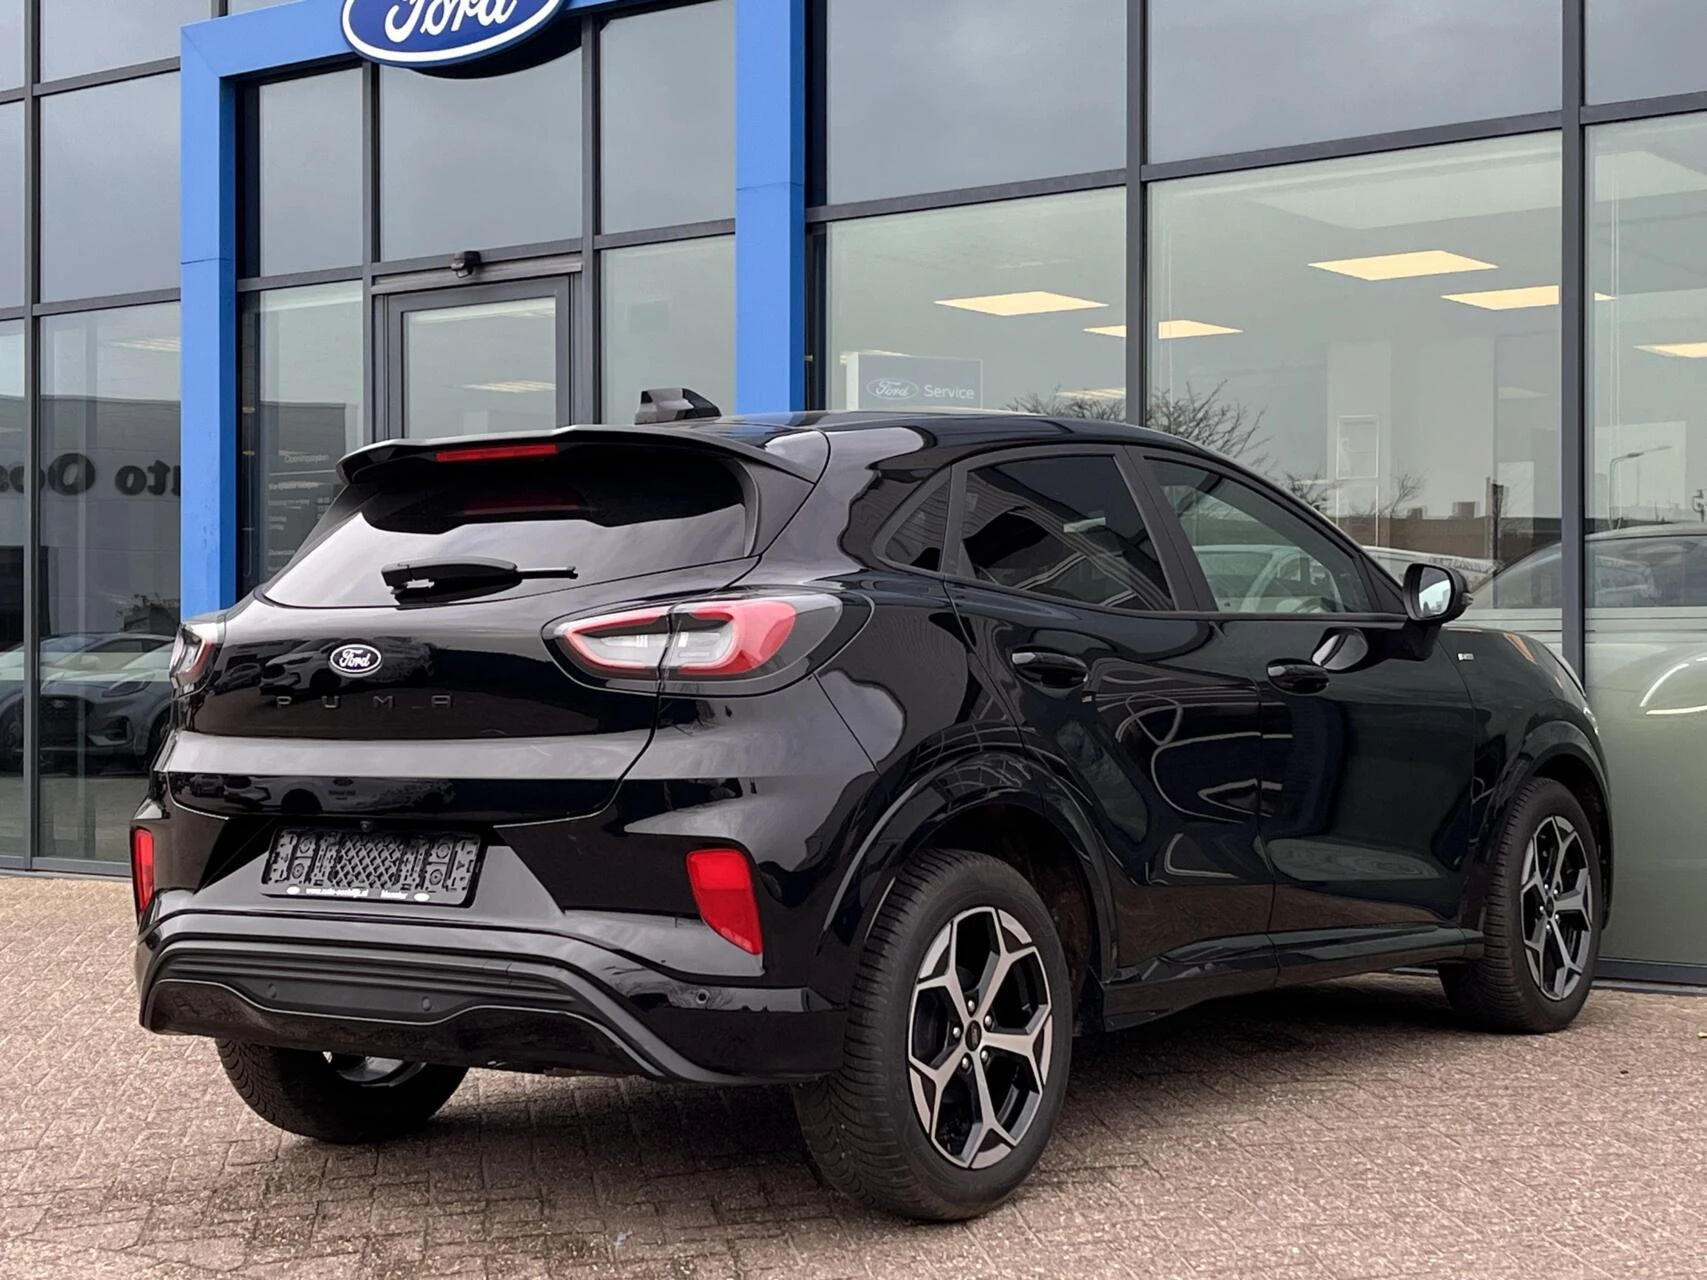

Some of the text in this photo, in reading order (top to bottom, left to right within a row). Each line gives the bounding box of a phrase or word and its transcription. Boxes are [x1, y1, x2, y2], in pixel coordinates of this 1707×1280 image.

[385, 0, 517, 43] Ford
[875, 381, 975, 399] Ford Service
[339, 648, 370, 667] Ford
